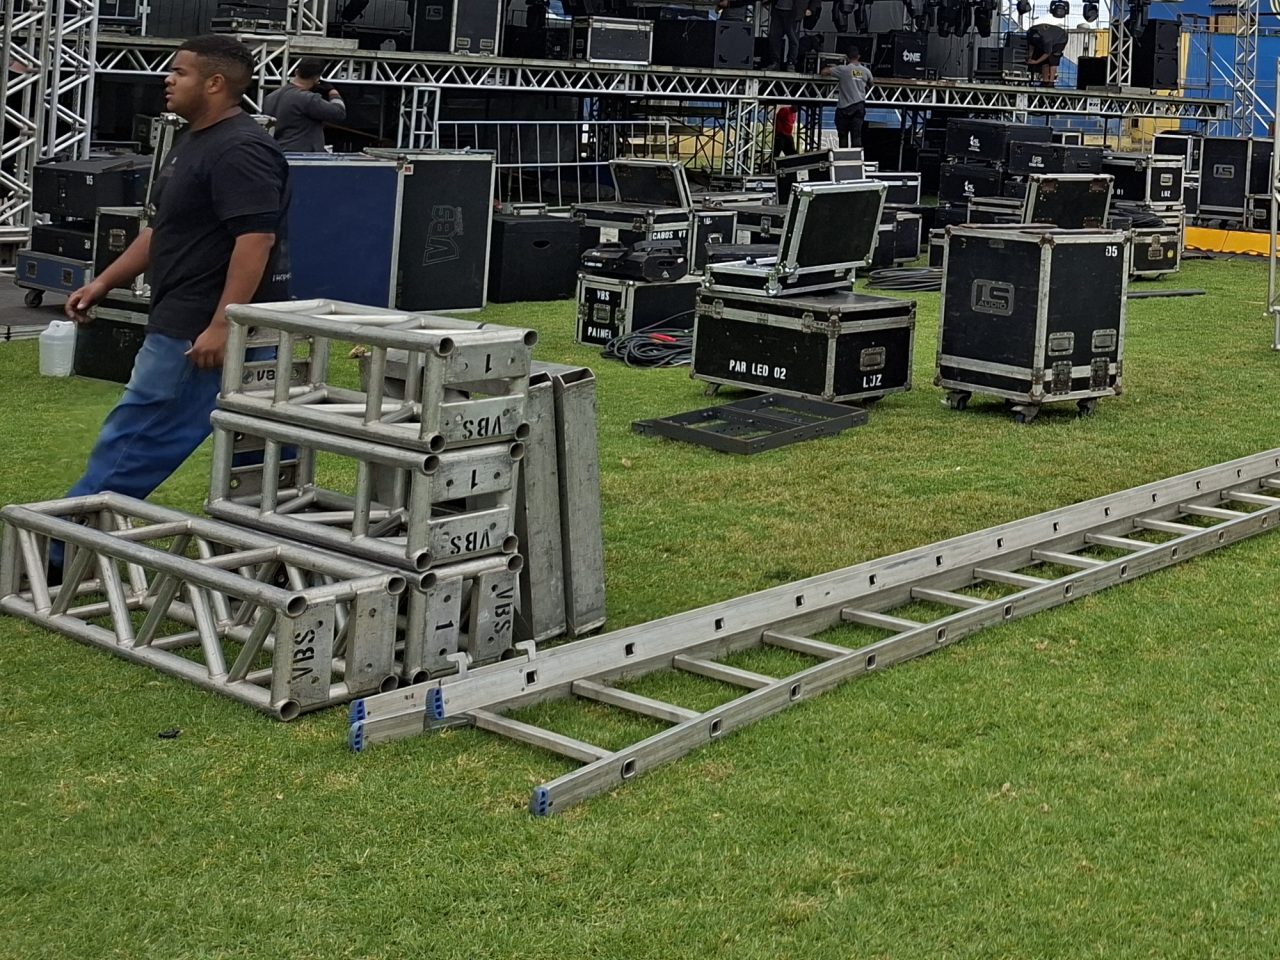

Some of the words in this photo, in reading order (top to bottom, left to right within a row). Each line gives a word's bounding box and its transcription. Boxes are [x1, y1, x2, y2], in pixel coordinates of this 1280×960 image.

[652, 231, 673, 240] CABOS
[678, 230, 686, 238] VT
[1105, 245, 1118, 257] 05
[596, 290, 610, 301] VBS
[977, 300, 1007, 310] AUDIO
[587, 326, 612, 339] PAINEL
[485, 353, 493, 374] 1
[729, 359, 747, 373] PAR
[751, 362, 769, 377] LED
[773, 367, 786, 380] 02
[257, 369, 276, 381] VB
[862, 374, 882, 388] LUZ
[462, 415, 502, 439] VBS
[470, 469, 478, 490] 1
[450, 528, 490, 554] VBS
[494, 586, 513, 634] VBS
[435, 620, 454, 631] 1
[292, 628, 315, 681] VBS
